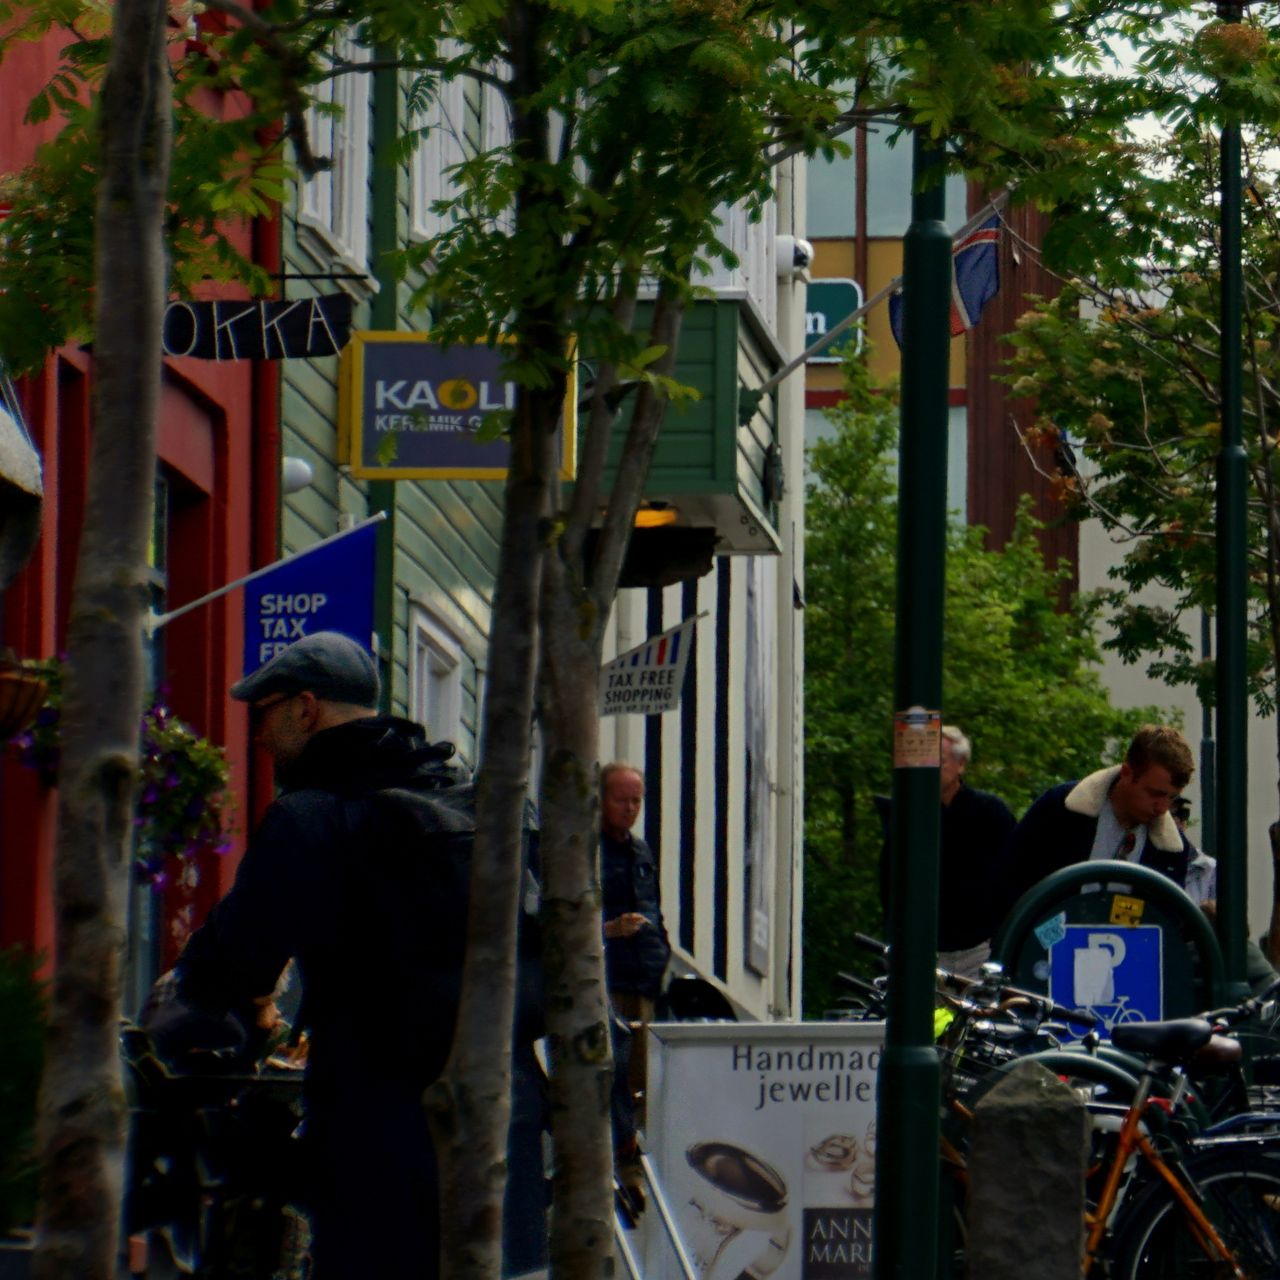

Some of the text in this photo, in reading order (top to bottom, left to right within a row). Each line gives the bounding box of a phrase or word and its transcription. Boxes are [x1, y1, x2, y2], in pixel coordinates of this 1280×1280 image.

[162, 297, 342, 362] OKKA
[375, 379, 516, 410] KAOLI
[260, 593, 327, 614] SHOP
[260, 618, 306, 639] TAX
[260, 642, 290, 663] FR
[608, 669, 676, 688] TAX FREE
[605, 687, 672, 705] SHOPPING
[732, 1044, 885, 1071] Handmad
[754, 1073, 872, 1111] jewelle
[810, 1218, 872, 1239] ANN
[809, 1243, 873, 1263] MARI
